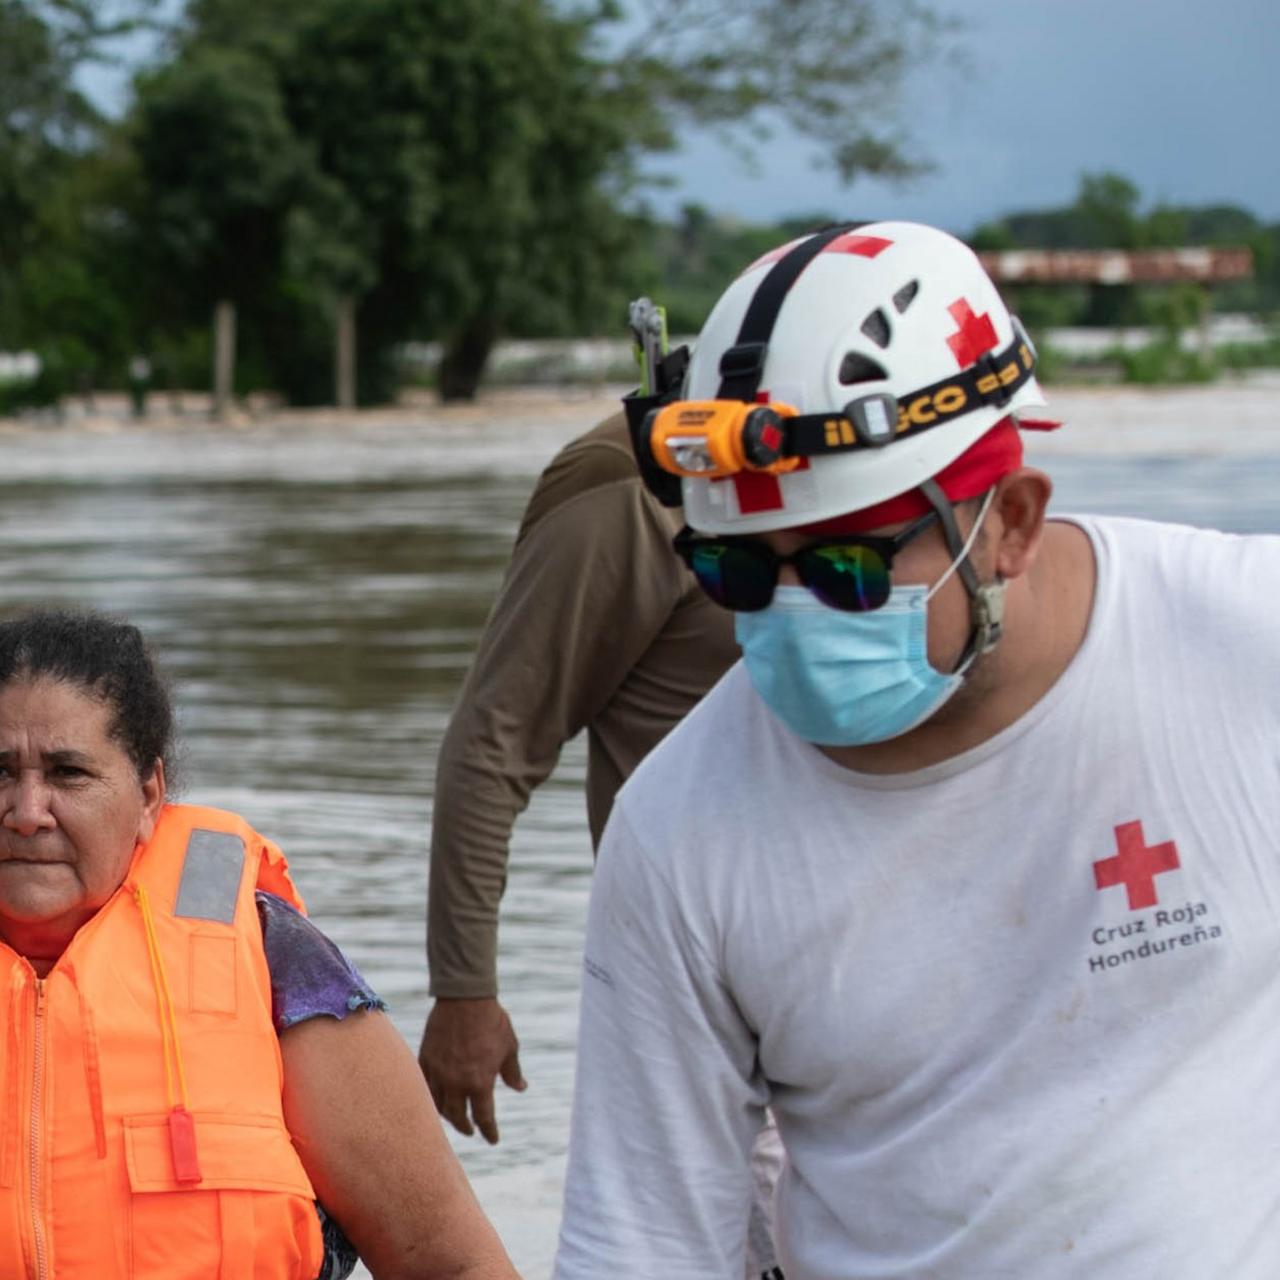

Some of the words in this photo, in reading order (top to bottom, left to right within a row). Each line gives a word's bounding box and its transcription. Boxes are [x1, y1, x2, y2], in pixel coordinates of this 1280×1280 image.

[1092, 919, 1146, 945] Cruz
[1154, 901, 1208, 927] Roja
[1088, 924, 1222, 972] Hondureña
